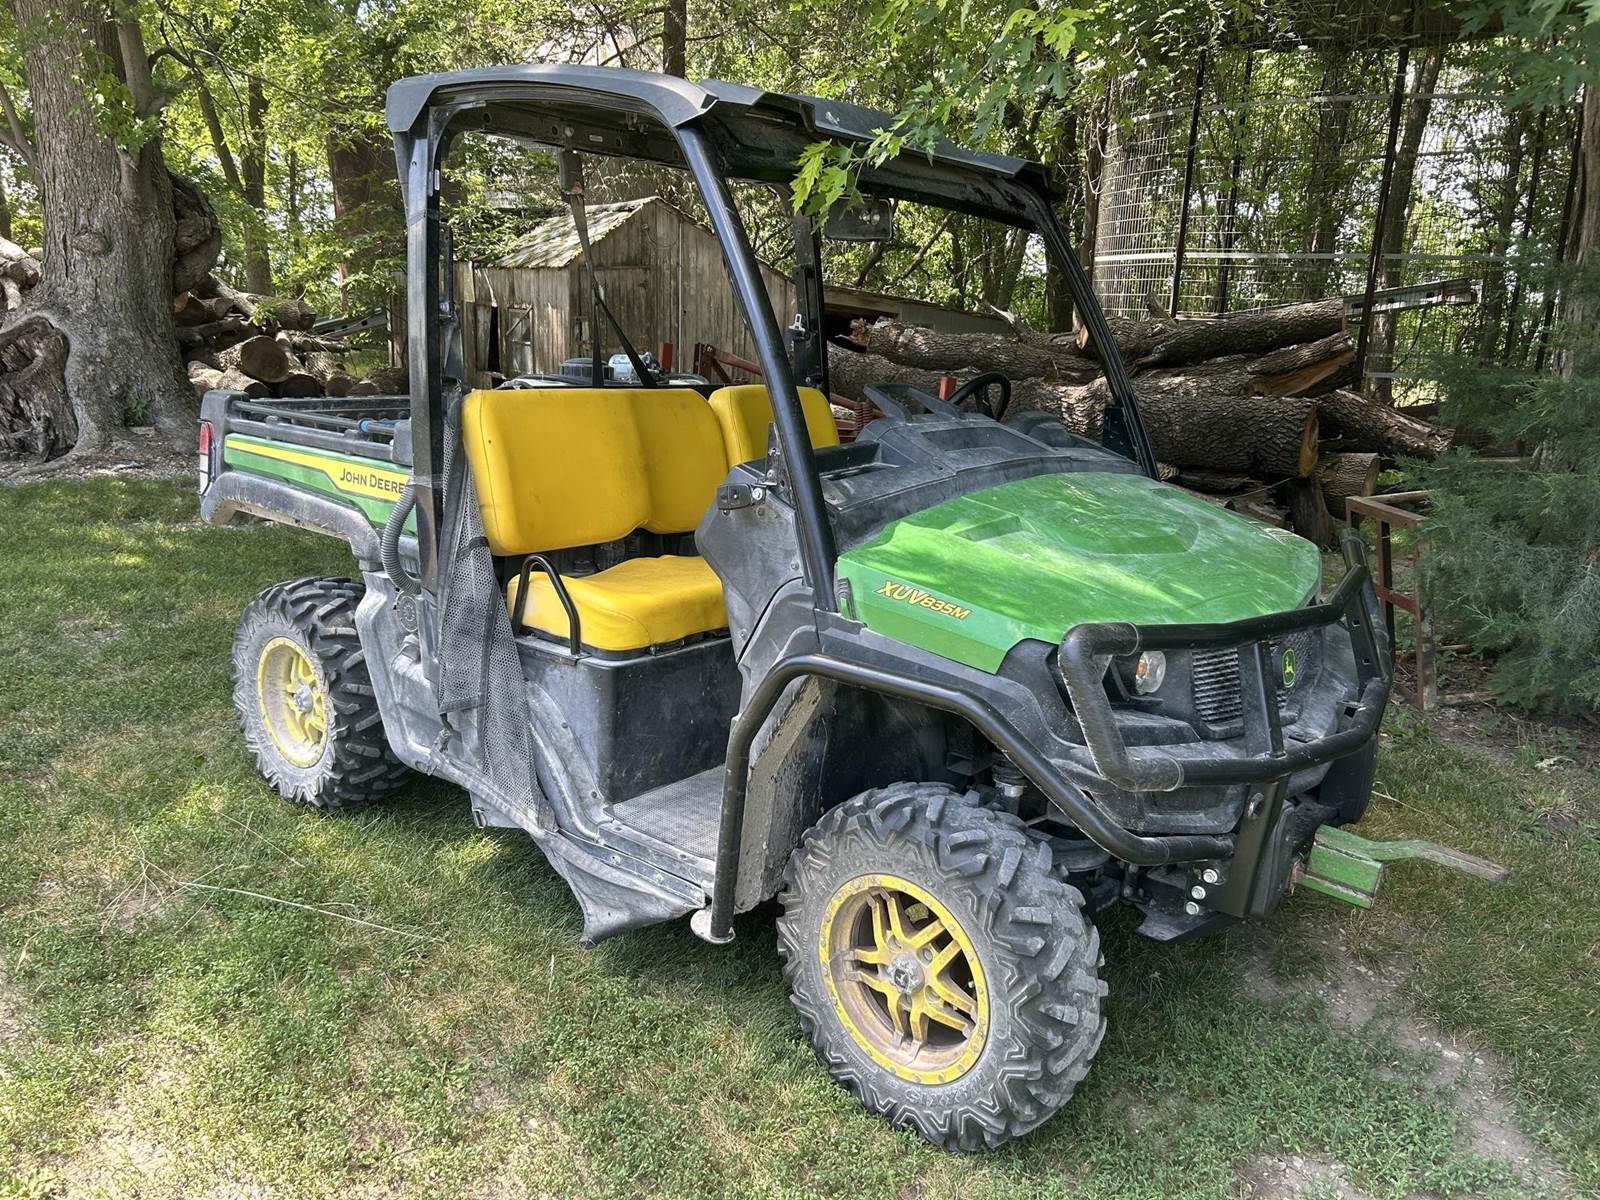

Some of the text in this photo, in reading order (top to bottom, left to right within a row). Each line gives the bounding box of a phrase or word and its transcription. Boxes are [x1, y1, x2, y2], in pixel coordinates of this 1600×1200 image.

[340, 468, 405, 493] JOHN DEERE
[873, 580, 972, 620] XUV835M
